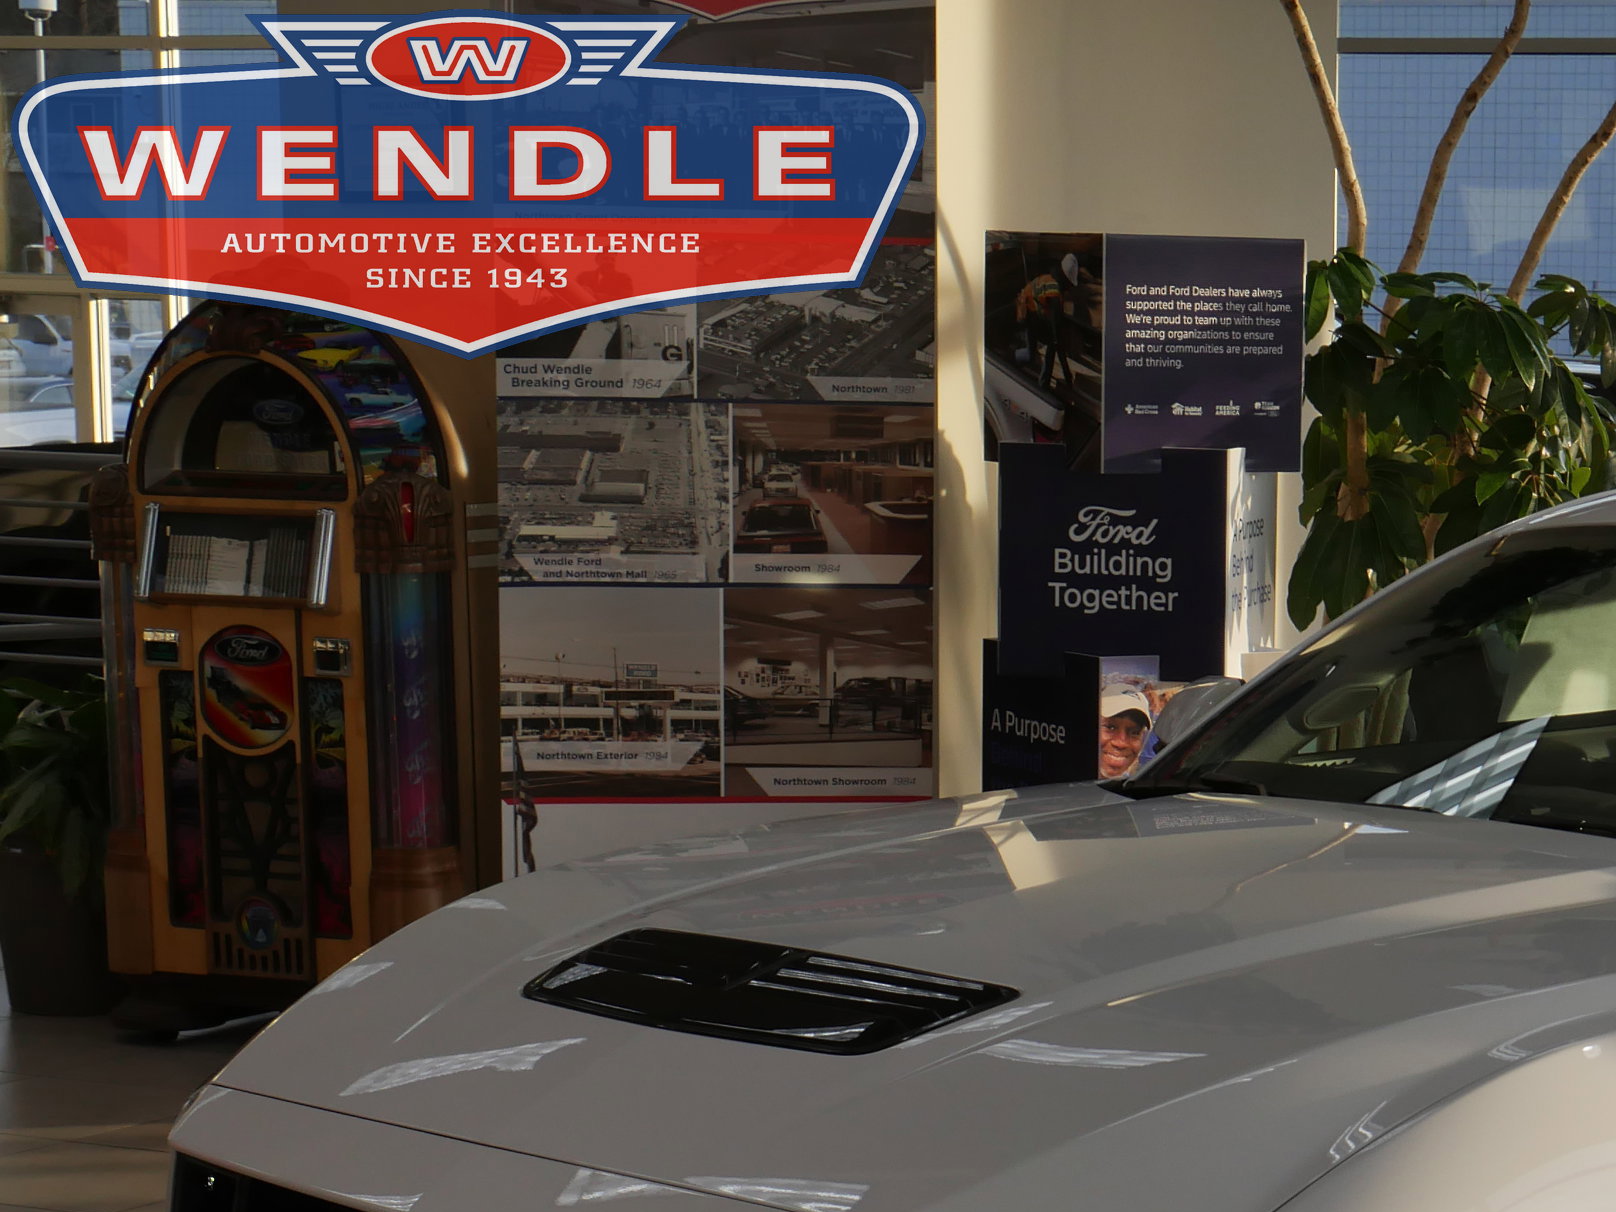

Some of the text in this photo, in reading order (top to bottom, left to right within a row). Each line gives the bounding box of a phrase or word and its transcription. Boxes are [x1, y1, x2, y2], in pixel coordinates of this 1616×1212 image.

[1126, 284, 1283, 300] Ford and Ford Dealers have always
[1126, 299, 1293, 314] supported the places they call home.
[1126, 313, 1281, 328] We're proud to team up with these
[1125, 328, 1274, 342] amazing organizations to ensure
[1126, 342, 1283, 357] that our communities are prepared
[503, 363, 593, 377] Chud Wendle
[1125, 356, 1184, 370] and thriving.
[511, 376, 663, 392] Breaking Ground 1964
[831, 383, 889, 395] Northtown
[1068, 505, 1158, 546] Ford
[533, 556, 603, 568] Wendle Ford
[754, 562, 841, 575] Showroom 1984
[1053, 548, 1173, 584] Building
[542, 568, 563, 580] and
[565, 568, 623, 580] Northtown
[625, 568, 649, 580] Mall
[1048, 582, 1179, 614] Together
[227, 638, 269, 661] Ford
[990, 708, 1066, 745] A Purpose
[536, 750, 669, 762] Northtown Exterior 1984
[773, 776, 829, 788] Northtown
[831, 776, 888, 788] Showroom
